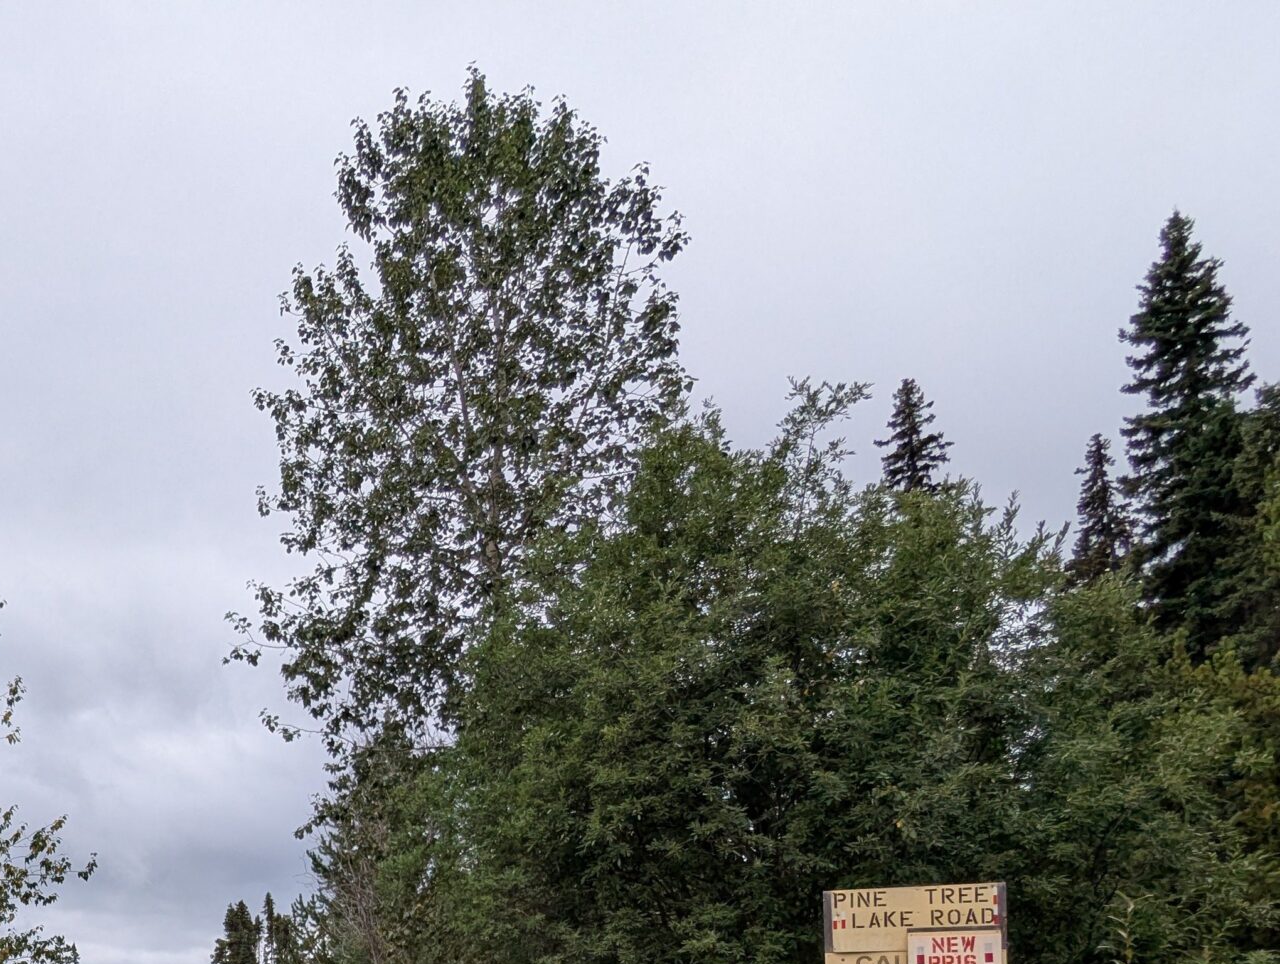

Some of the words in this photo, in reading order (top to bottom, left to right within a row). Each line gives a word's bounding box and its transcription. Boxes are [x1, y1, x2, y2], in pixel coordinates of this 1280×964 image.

[833, 891, 887, 908] PINE
[925, 886, 988, 904] TREE
[852, 911, 913, 928] LAKE
[931, 907, 994, 925] ROAD
[932, 936, 976, 953] NEW
